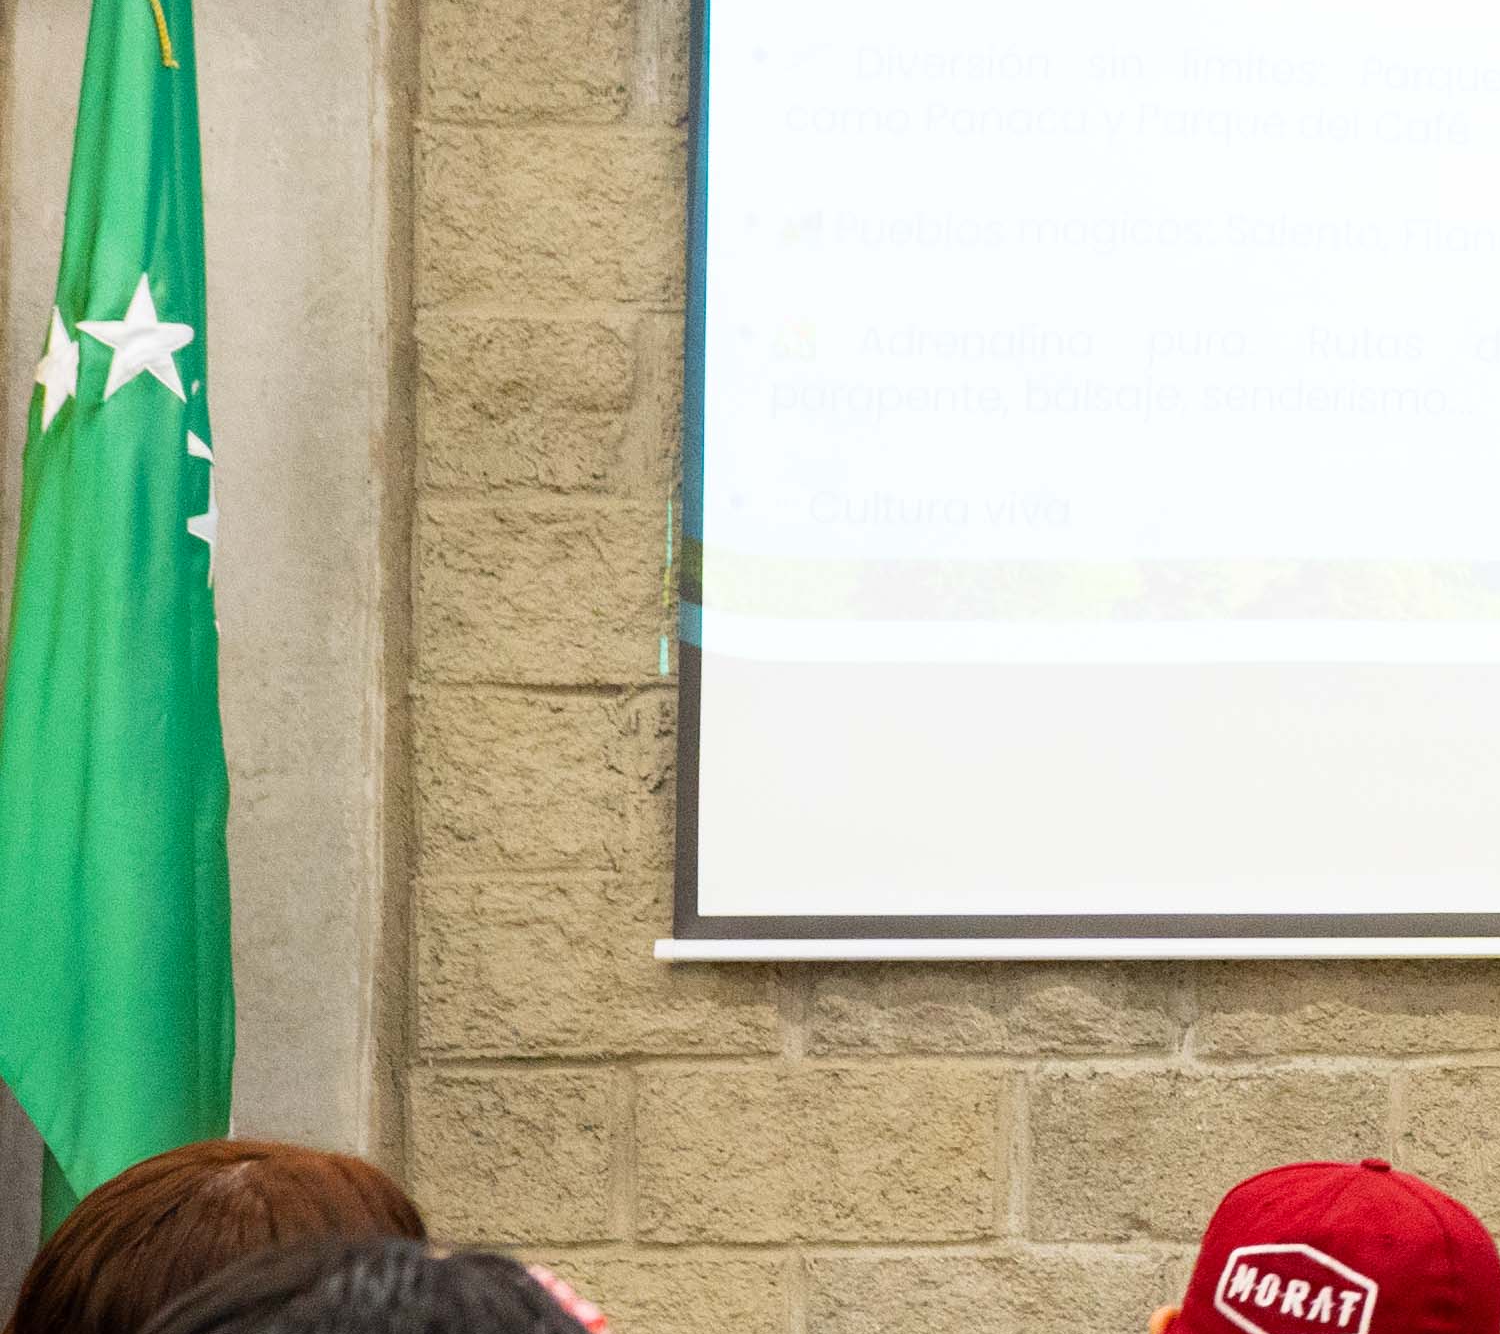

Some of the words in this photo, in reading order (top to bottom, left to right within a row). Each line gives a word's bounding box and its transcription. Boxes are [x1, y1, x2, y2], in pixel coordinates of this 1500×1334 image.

[856, 43, 1051, 81] Diversión
[1088, 45, 1144, 81] sin
[785, 106, 910, 135] como
[1102, 108, 1125, 147] y
[1135, 101, 1286, 147] Parque
[1298, 108, 1358, 143] del
[834, 208, 1006, 249] Pueblos
[859, 323, 1094, 361] Adrenalina
[1307, 324, 1424, 362] Rutas
[809, 490, 970, 527] Cultura
[984, 493, 1073, 527] viva
[1228, 1263, 1362, 1328] MORAT
